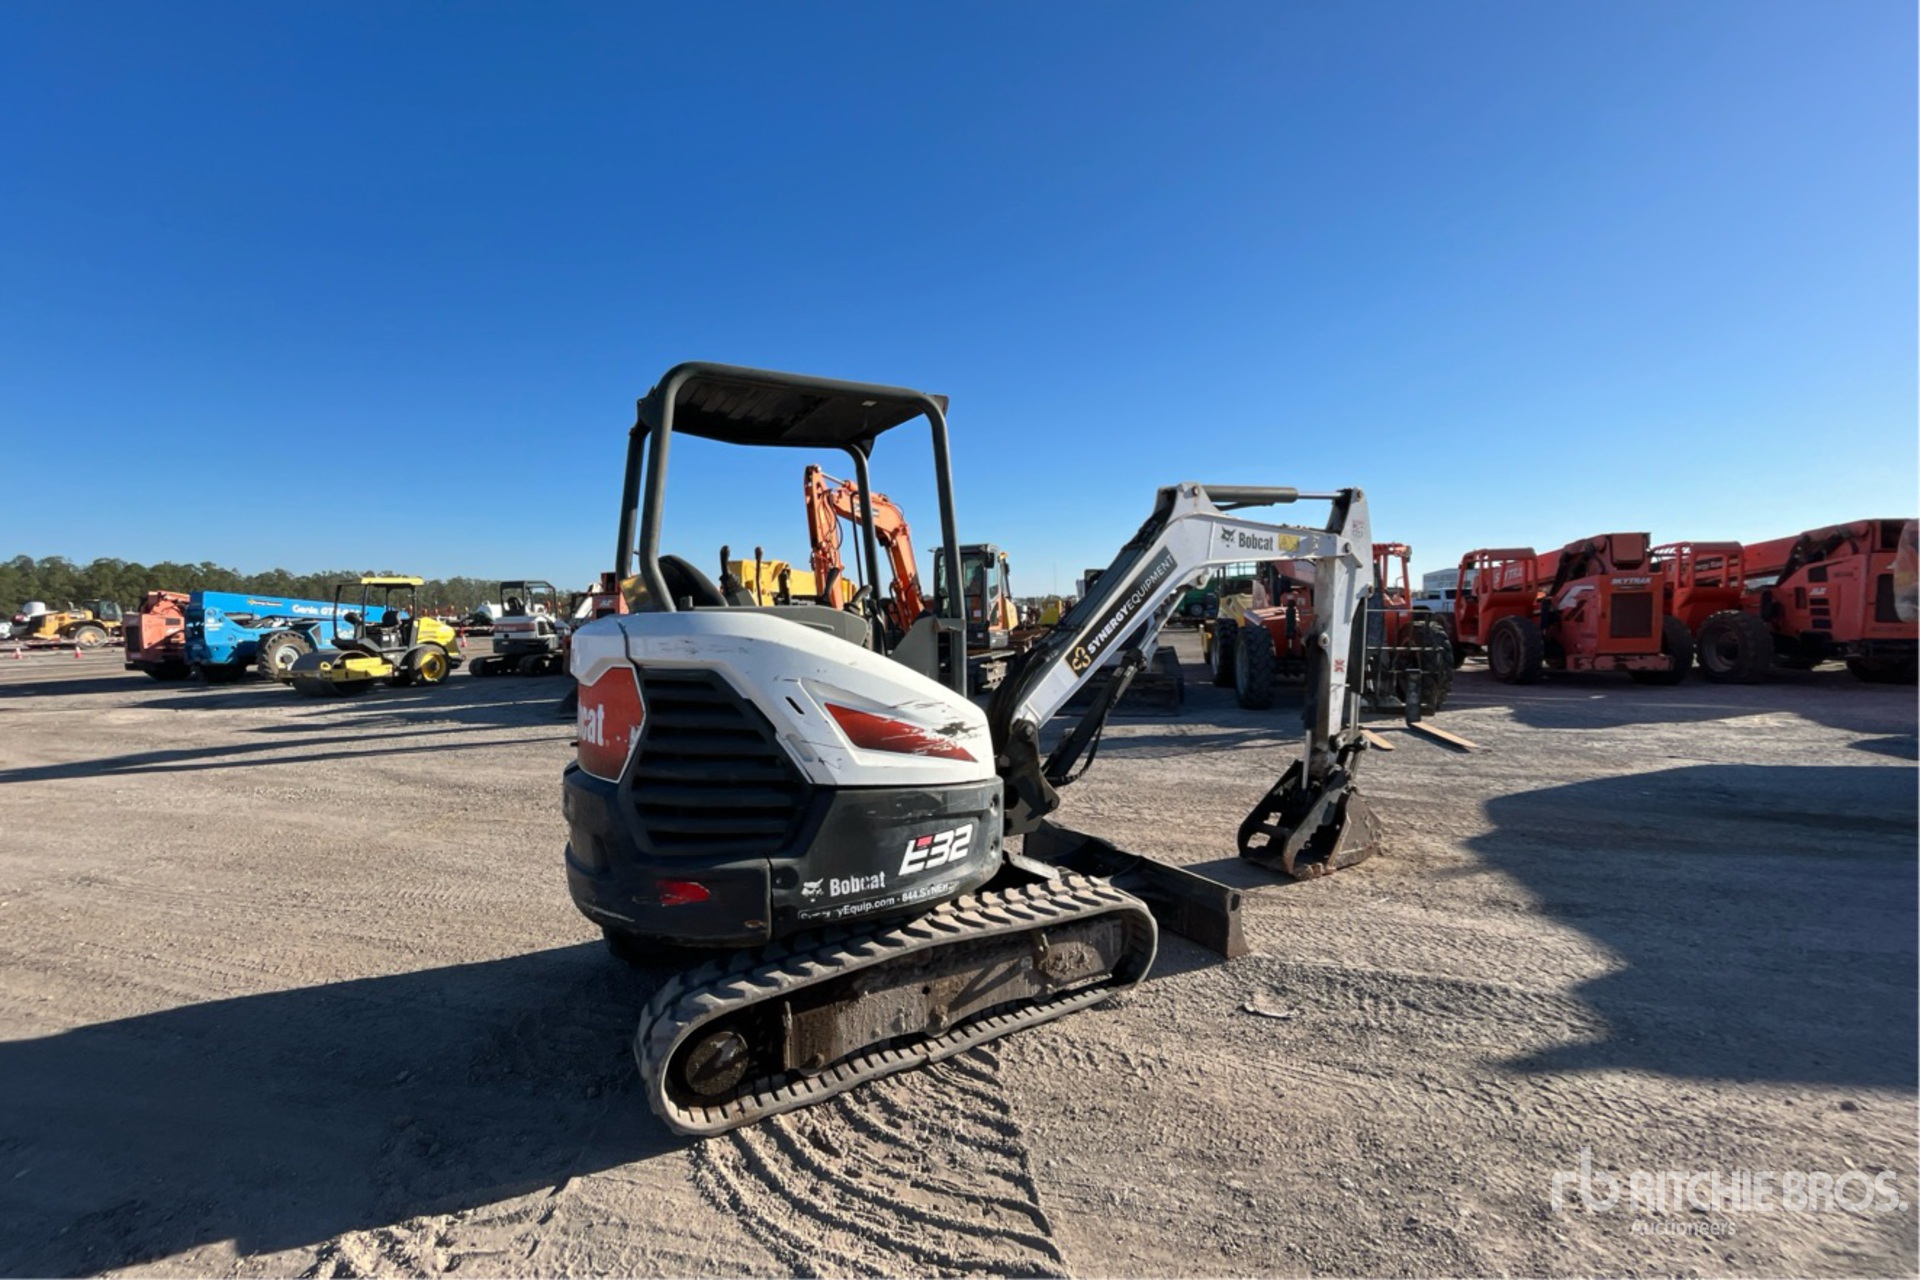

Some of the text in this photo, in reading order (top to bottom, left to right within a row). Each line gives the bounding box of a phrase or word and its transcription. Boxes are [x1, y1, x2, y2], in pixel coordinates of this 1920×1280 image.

[1238, 532, 1274, 551] Bobcat
[578, 696, 604, 747] cat
[897, 823, 974, 876] E32
[829, 870, 886, 897] Bobcat
